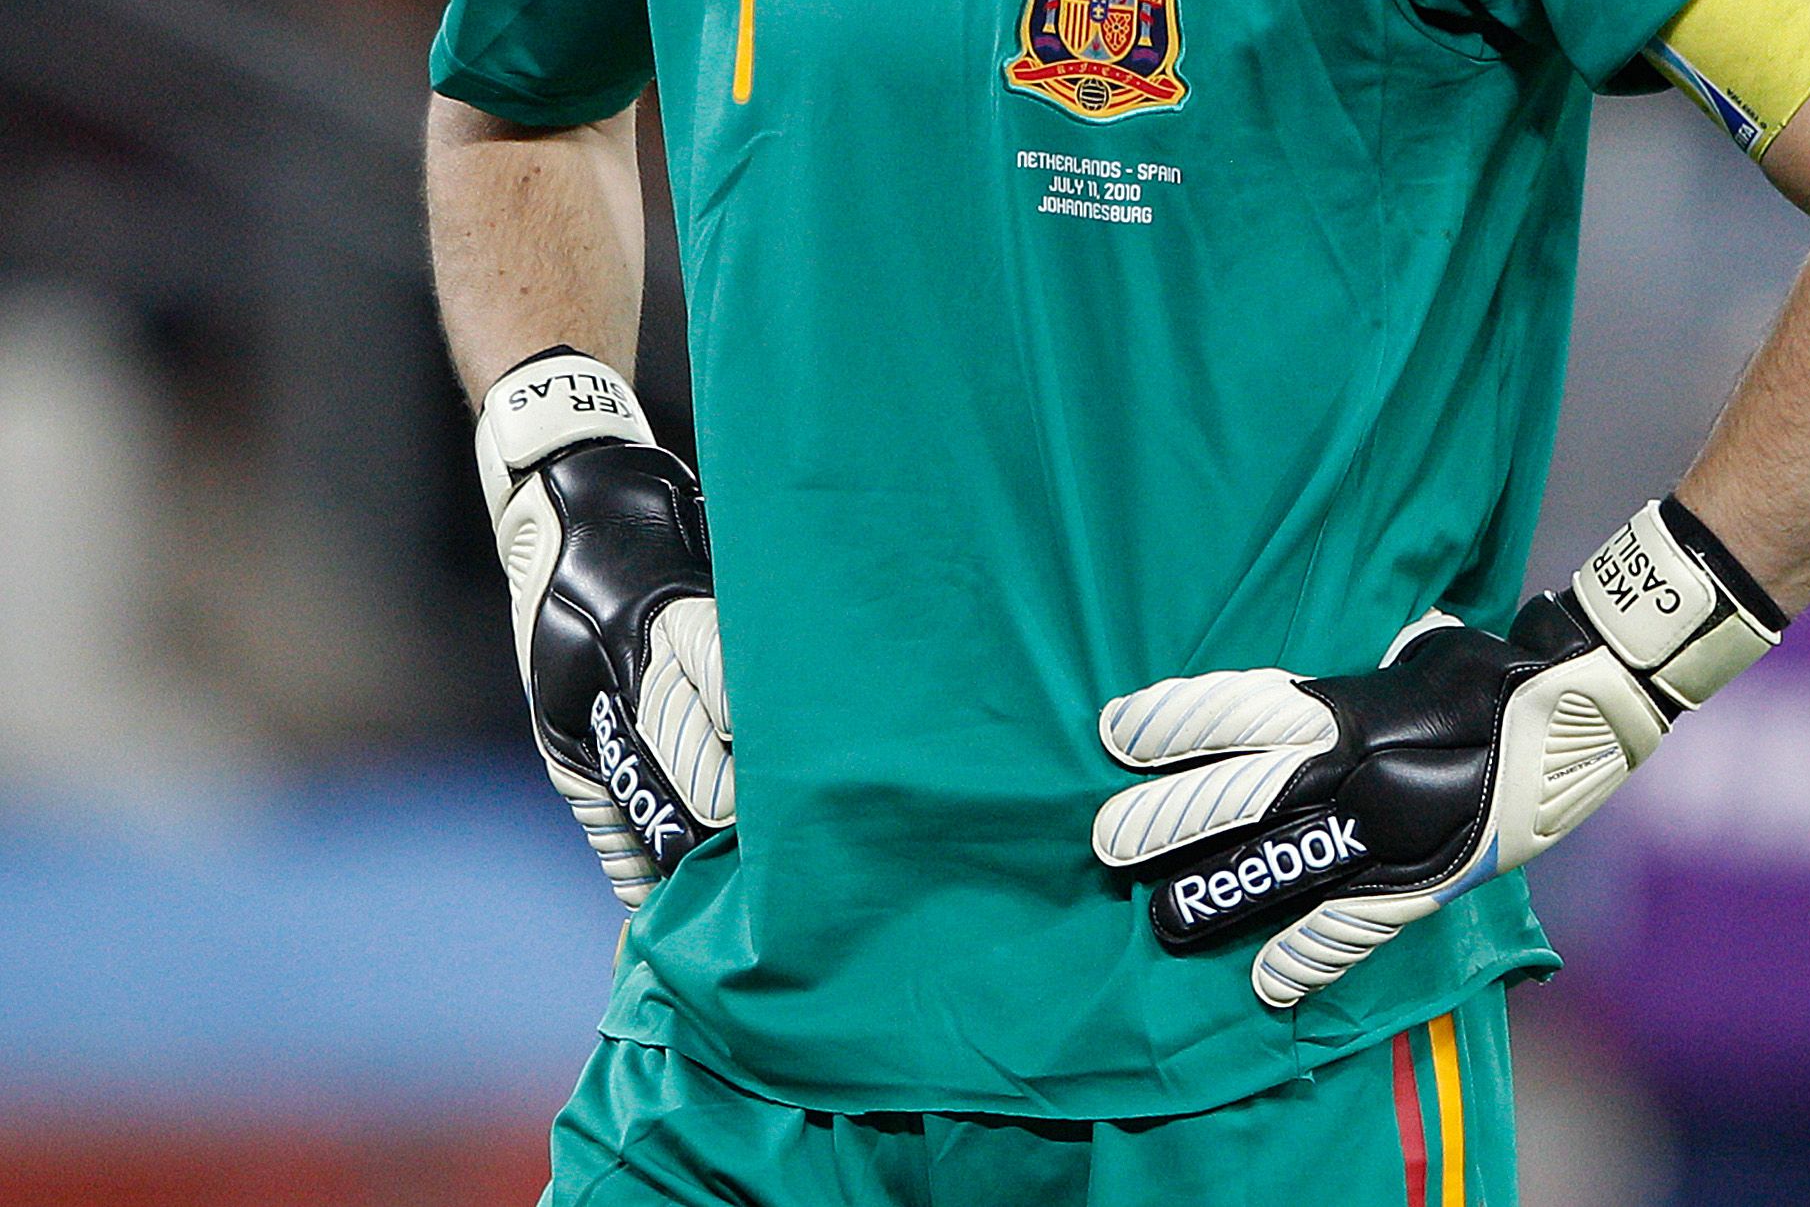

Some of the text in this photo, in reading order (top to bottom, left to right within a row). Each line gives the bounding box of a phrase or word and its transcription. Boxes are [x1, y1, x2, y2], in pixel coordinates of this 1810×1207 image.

[1016, 150, 1122, 179] NETHERLANDS
[1137, 163, 1181, 184] SPAIN
[1049, 176, 1141, 202] JULY 11, 2010
[1037, 196, 1153, 224] JOHANNESBURG
[1592, 546, 1639, 613] IKER
[591, 690, 685, 861] Reebok
[1173, 815, 1368, 926] Reebok
